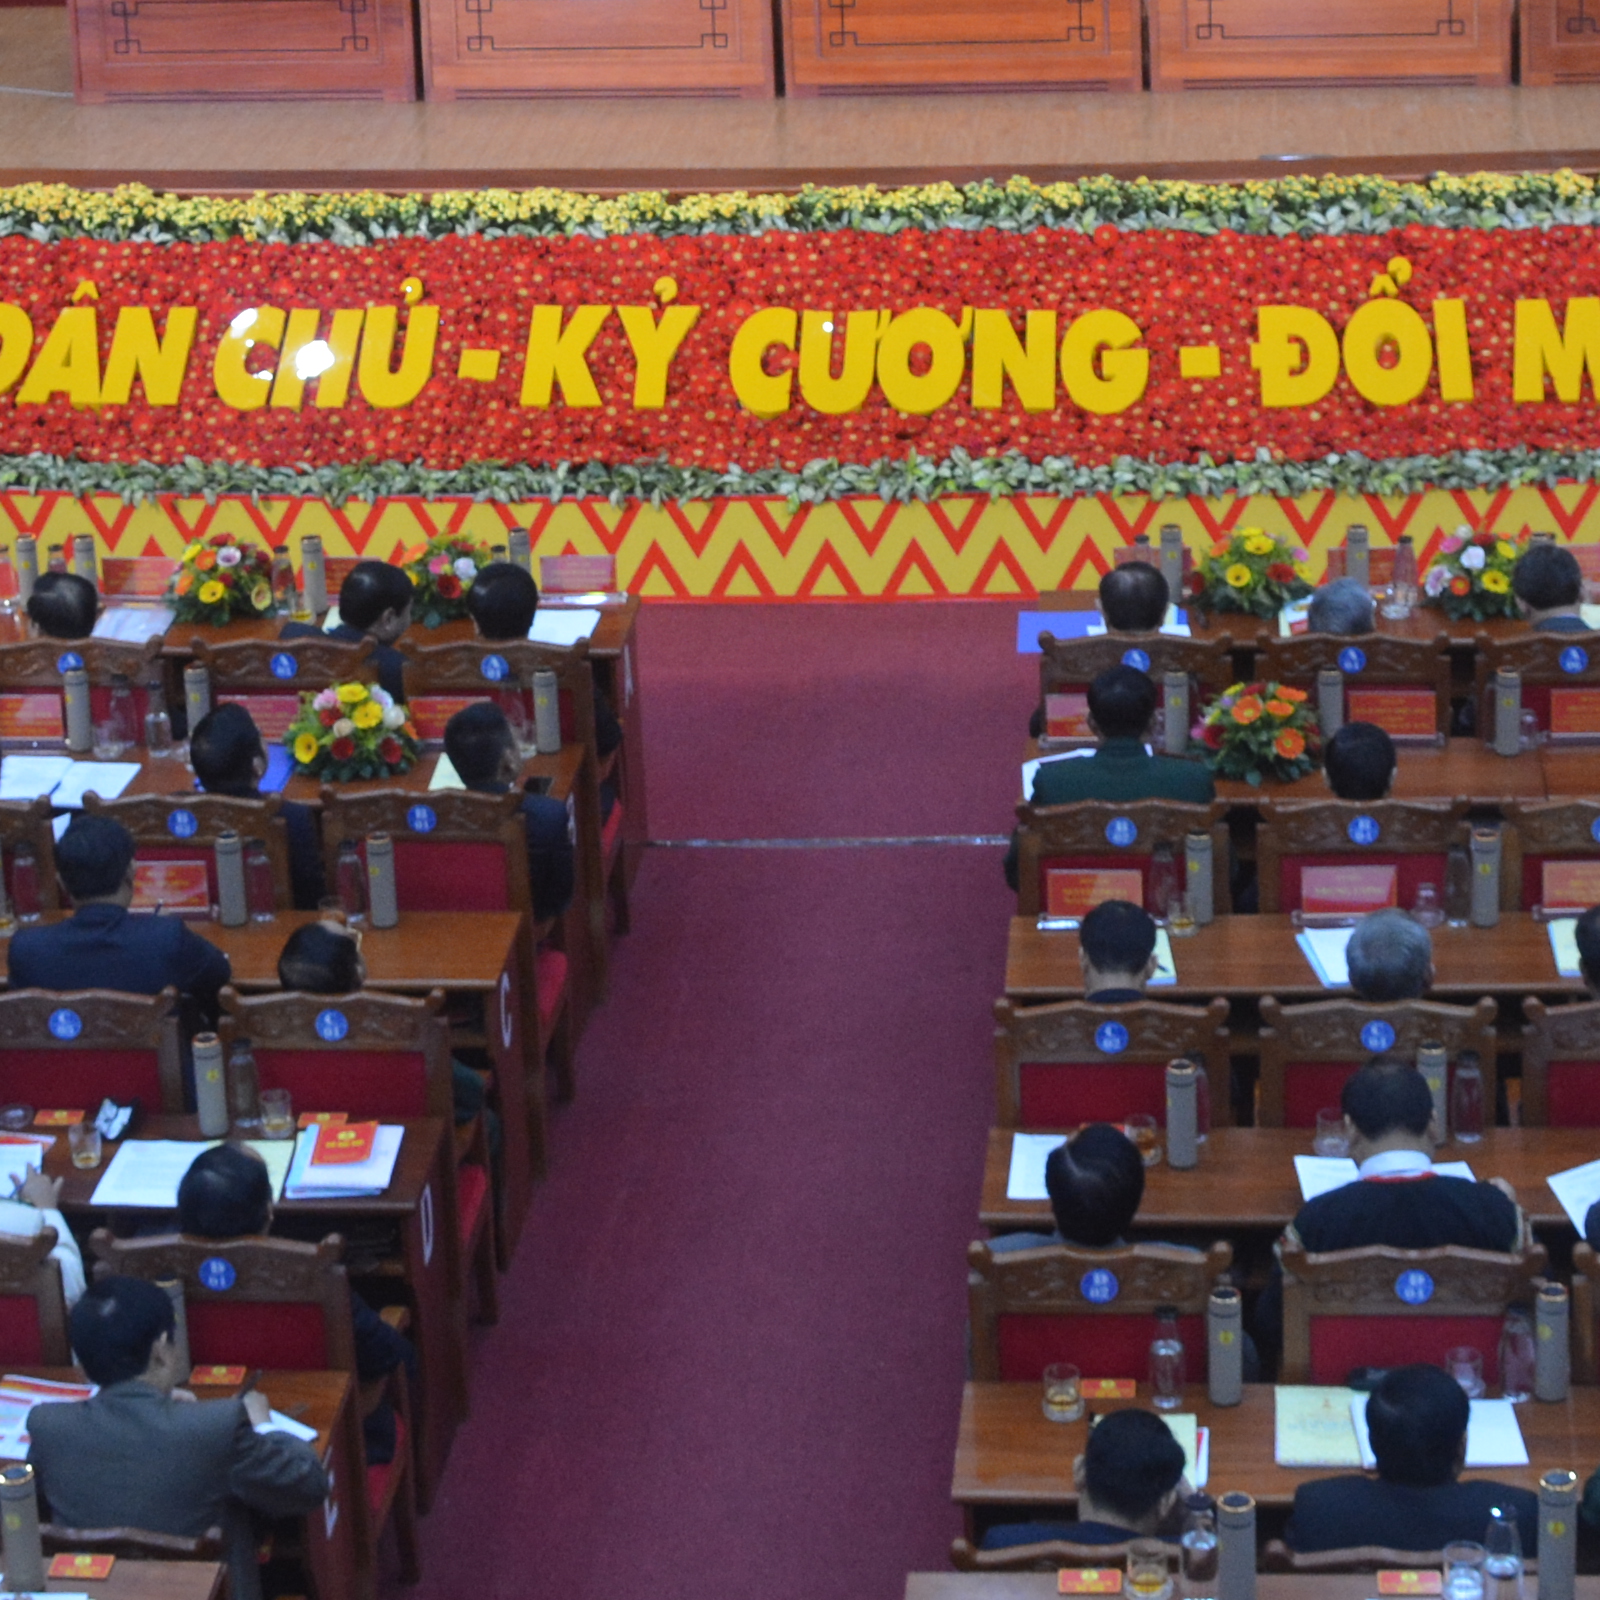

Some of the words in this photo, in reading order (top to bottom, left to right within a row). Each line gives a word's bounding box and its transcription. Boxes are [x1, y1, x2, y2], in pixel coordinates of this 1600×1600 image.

[213, 277, 439, 412] CHỦ
[520, 275, 700, 409] KỶ
[730, 305, 1149, 417] CƯƠNG
[1250, 256, 1474, 407] ĐỔI
